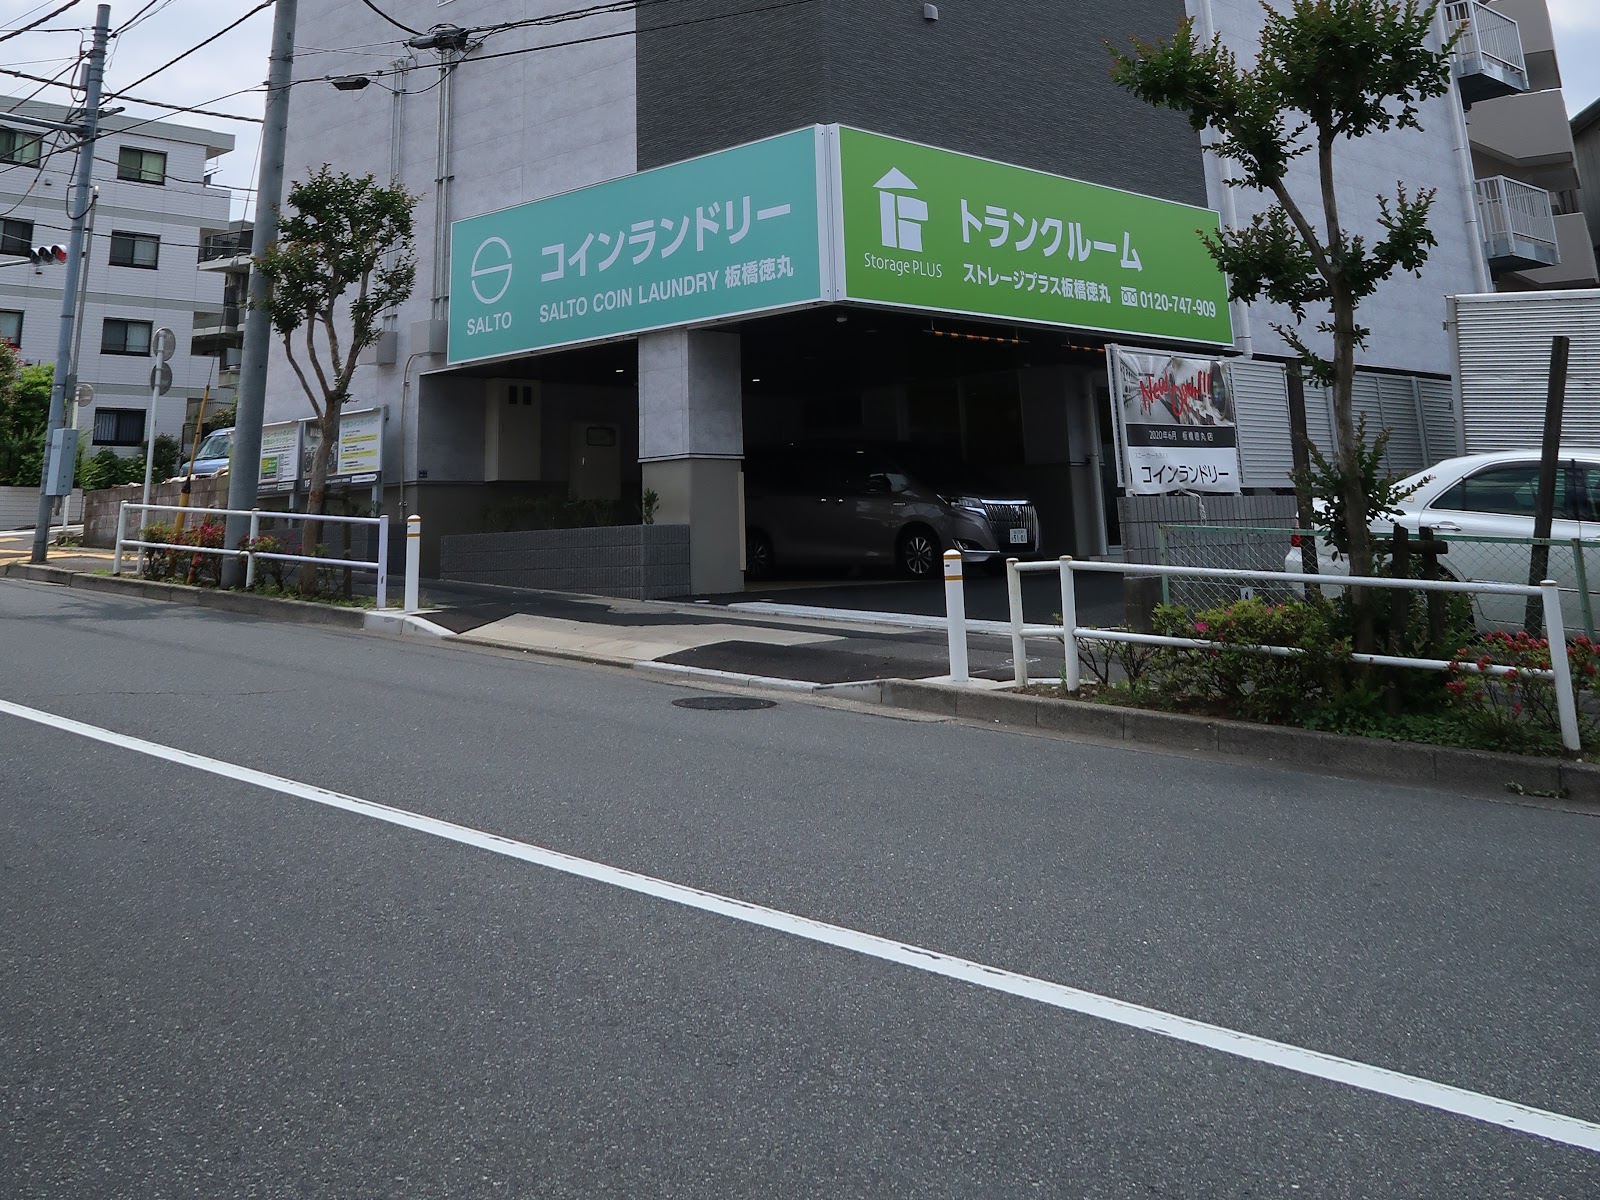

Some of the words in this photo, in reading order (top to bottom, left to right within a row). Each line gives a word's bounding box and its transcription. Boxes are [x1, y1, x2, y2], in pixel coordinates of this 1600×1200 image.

[541, 195, 791, 282] コインランドリー
[960, 198, 1143, 272] トランクルーム
[864, 252, 910, 276] Storage
[912, 259, 943, 278] PLUS
[539, 296, 588, 323] SALTO
[592, 287, 632, 313] COIN
[638, 270, 719, 305] LAUNDRY
[725, 254, 794, 288] 板橋徳丸
[963, 263, 1111, 304] ストレージプラス板橋徳丸
[1140, 290, 1216, 318] 0120-747-909
[466, 311, 512, 336] SALTO
[1148, 430, 1177, 441] 2020年6月
[1141, 464, 1229, 484] コインランドリー
